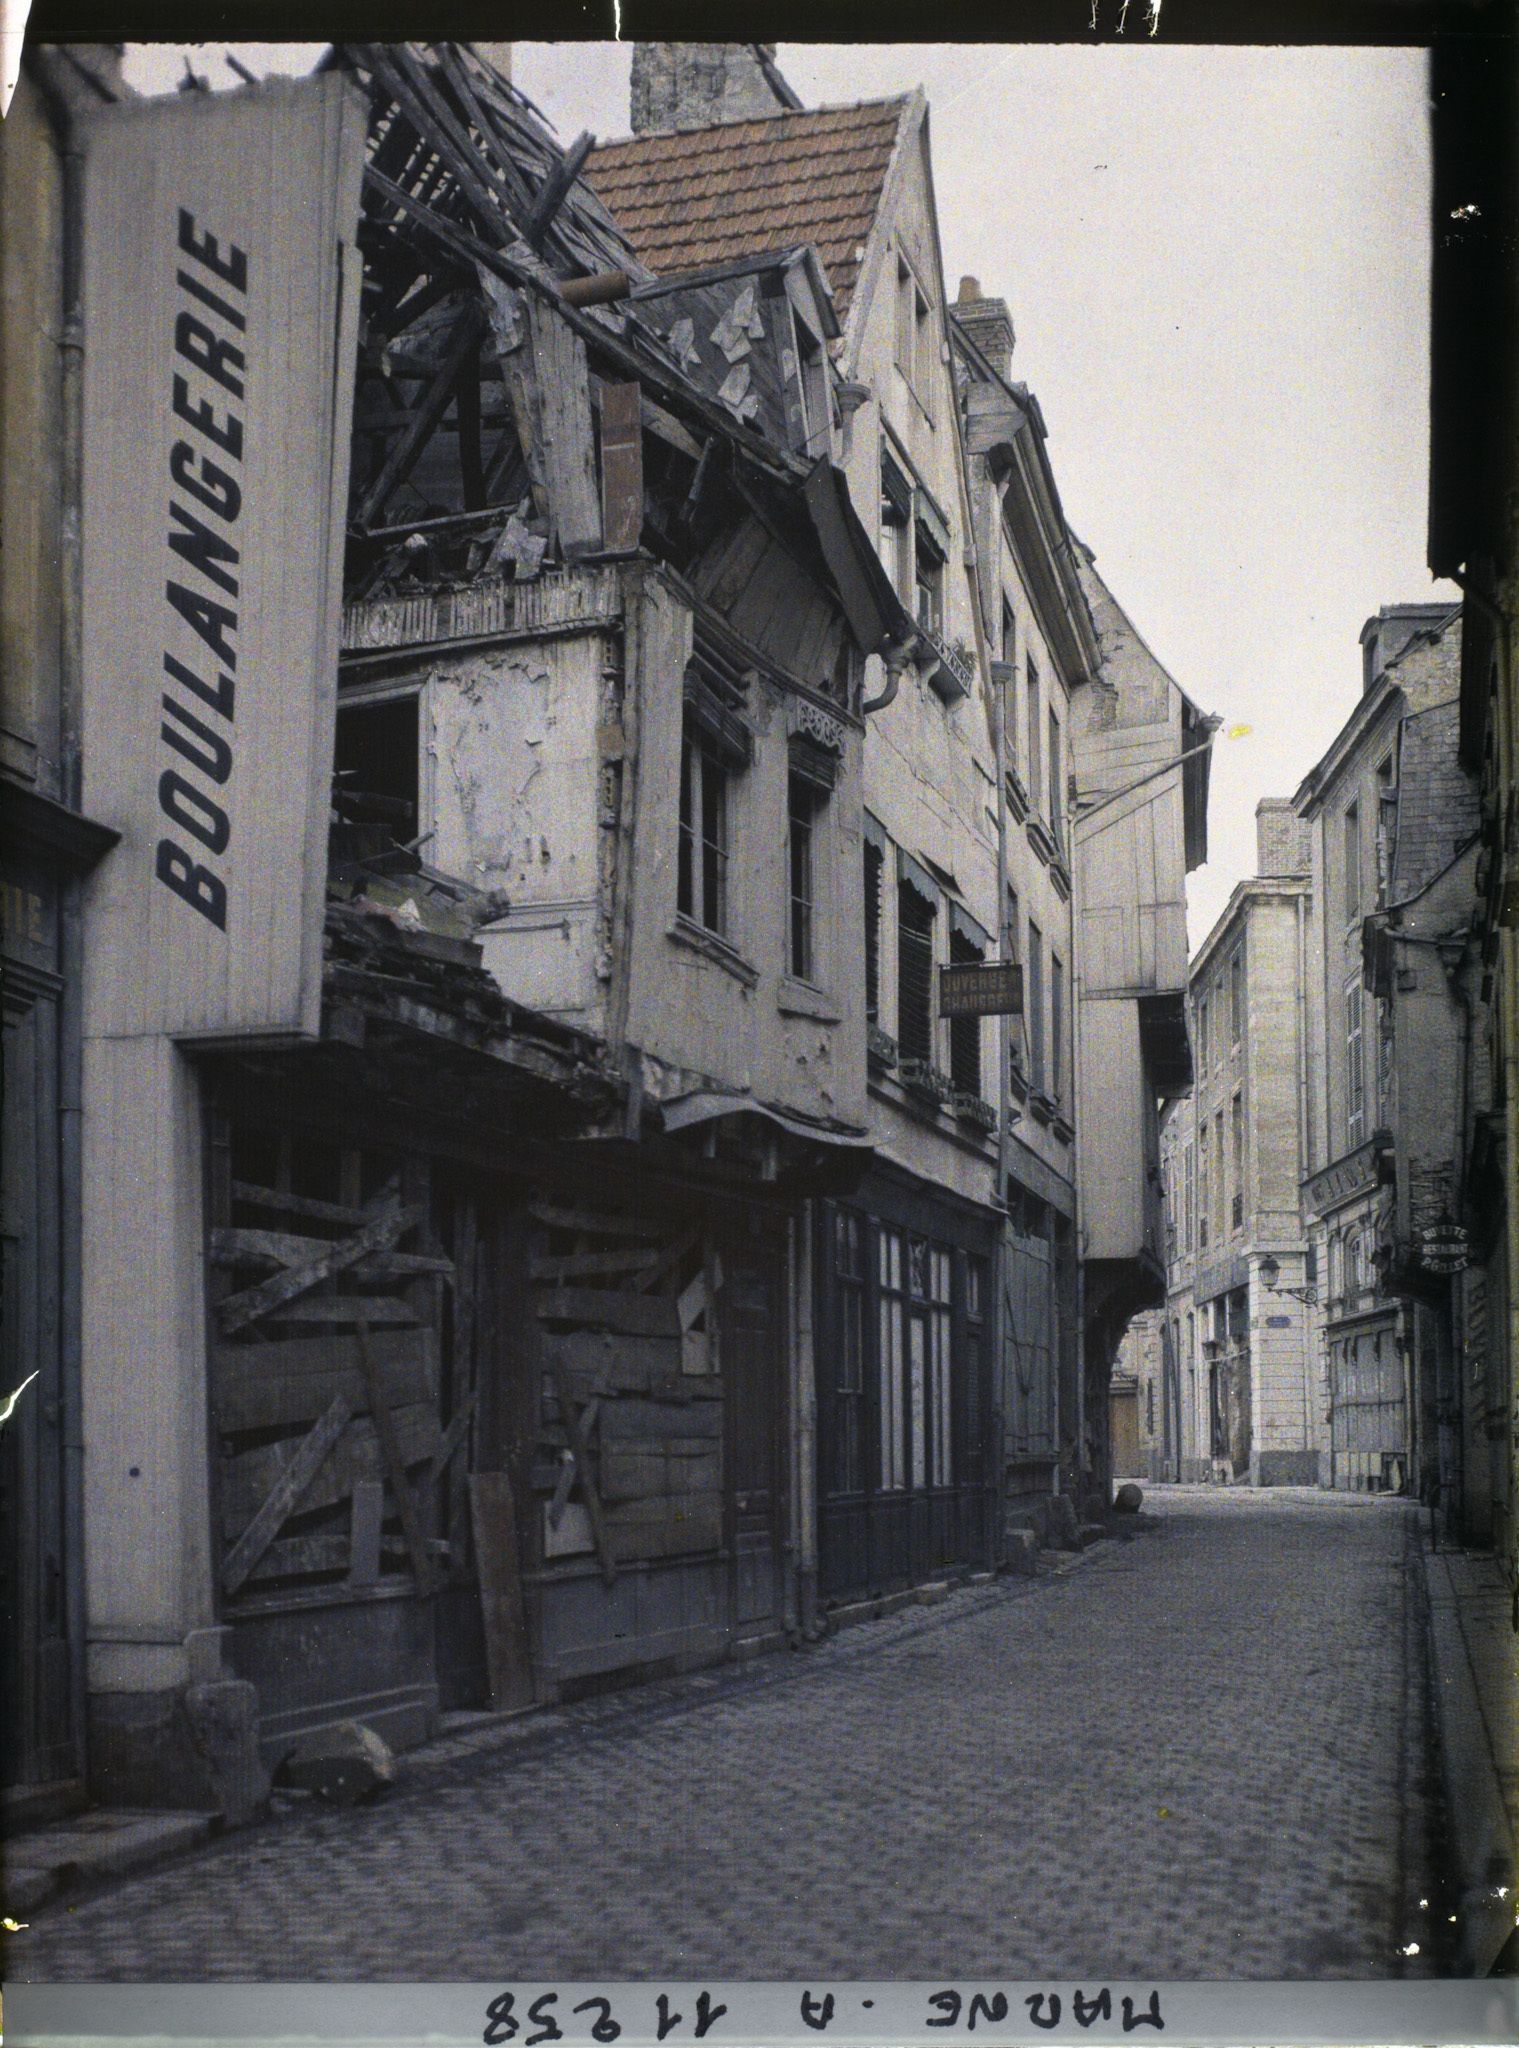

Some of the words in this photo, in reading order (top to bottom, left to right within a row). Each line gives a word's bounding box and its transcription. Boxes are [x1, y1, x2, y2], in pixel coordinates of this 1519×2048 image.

[155, 207, 247, 932] BOULANGERIE
[1421, 1225, 1469, 1241] BUVETTE
[800, 1990, 835, 2030] A
[925, 1988, 1165, 2032] MARNE
